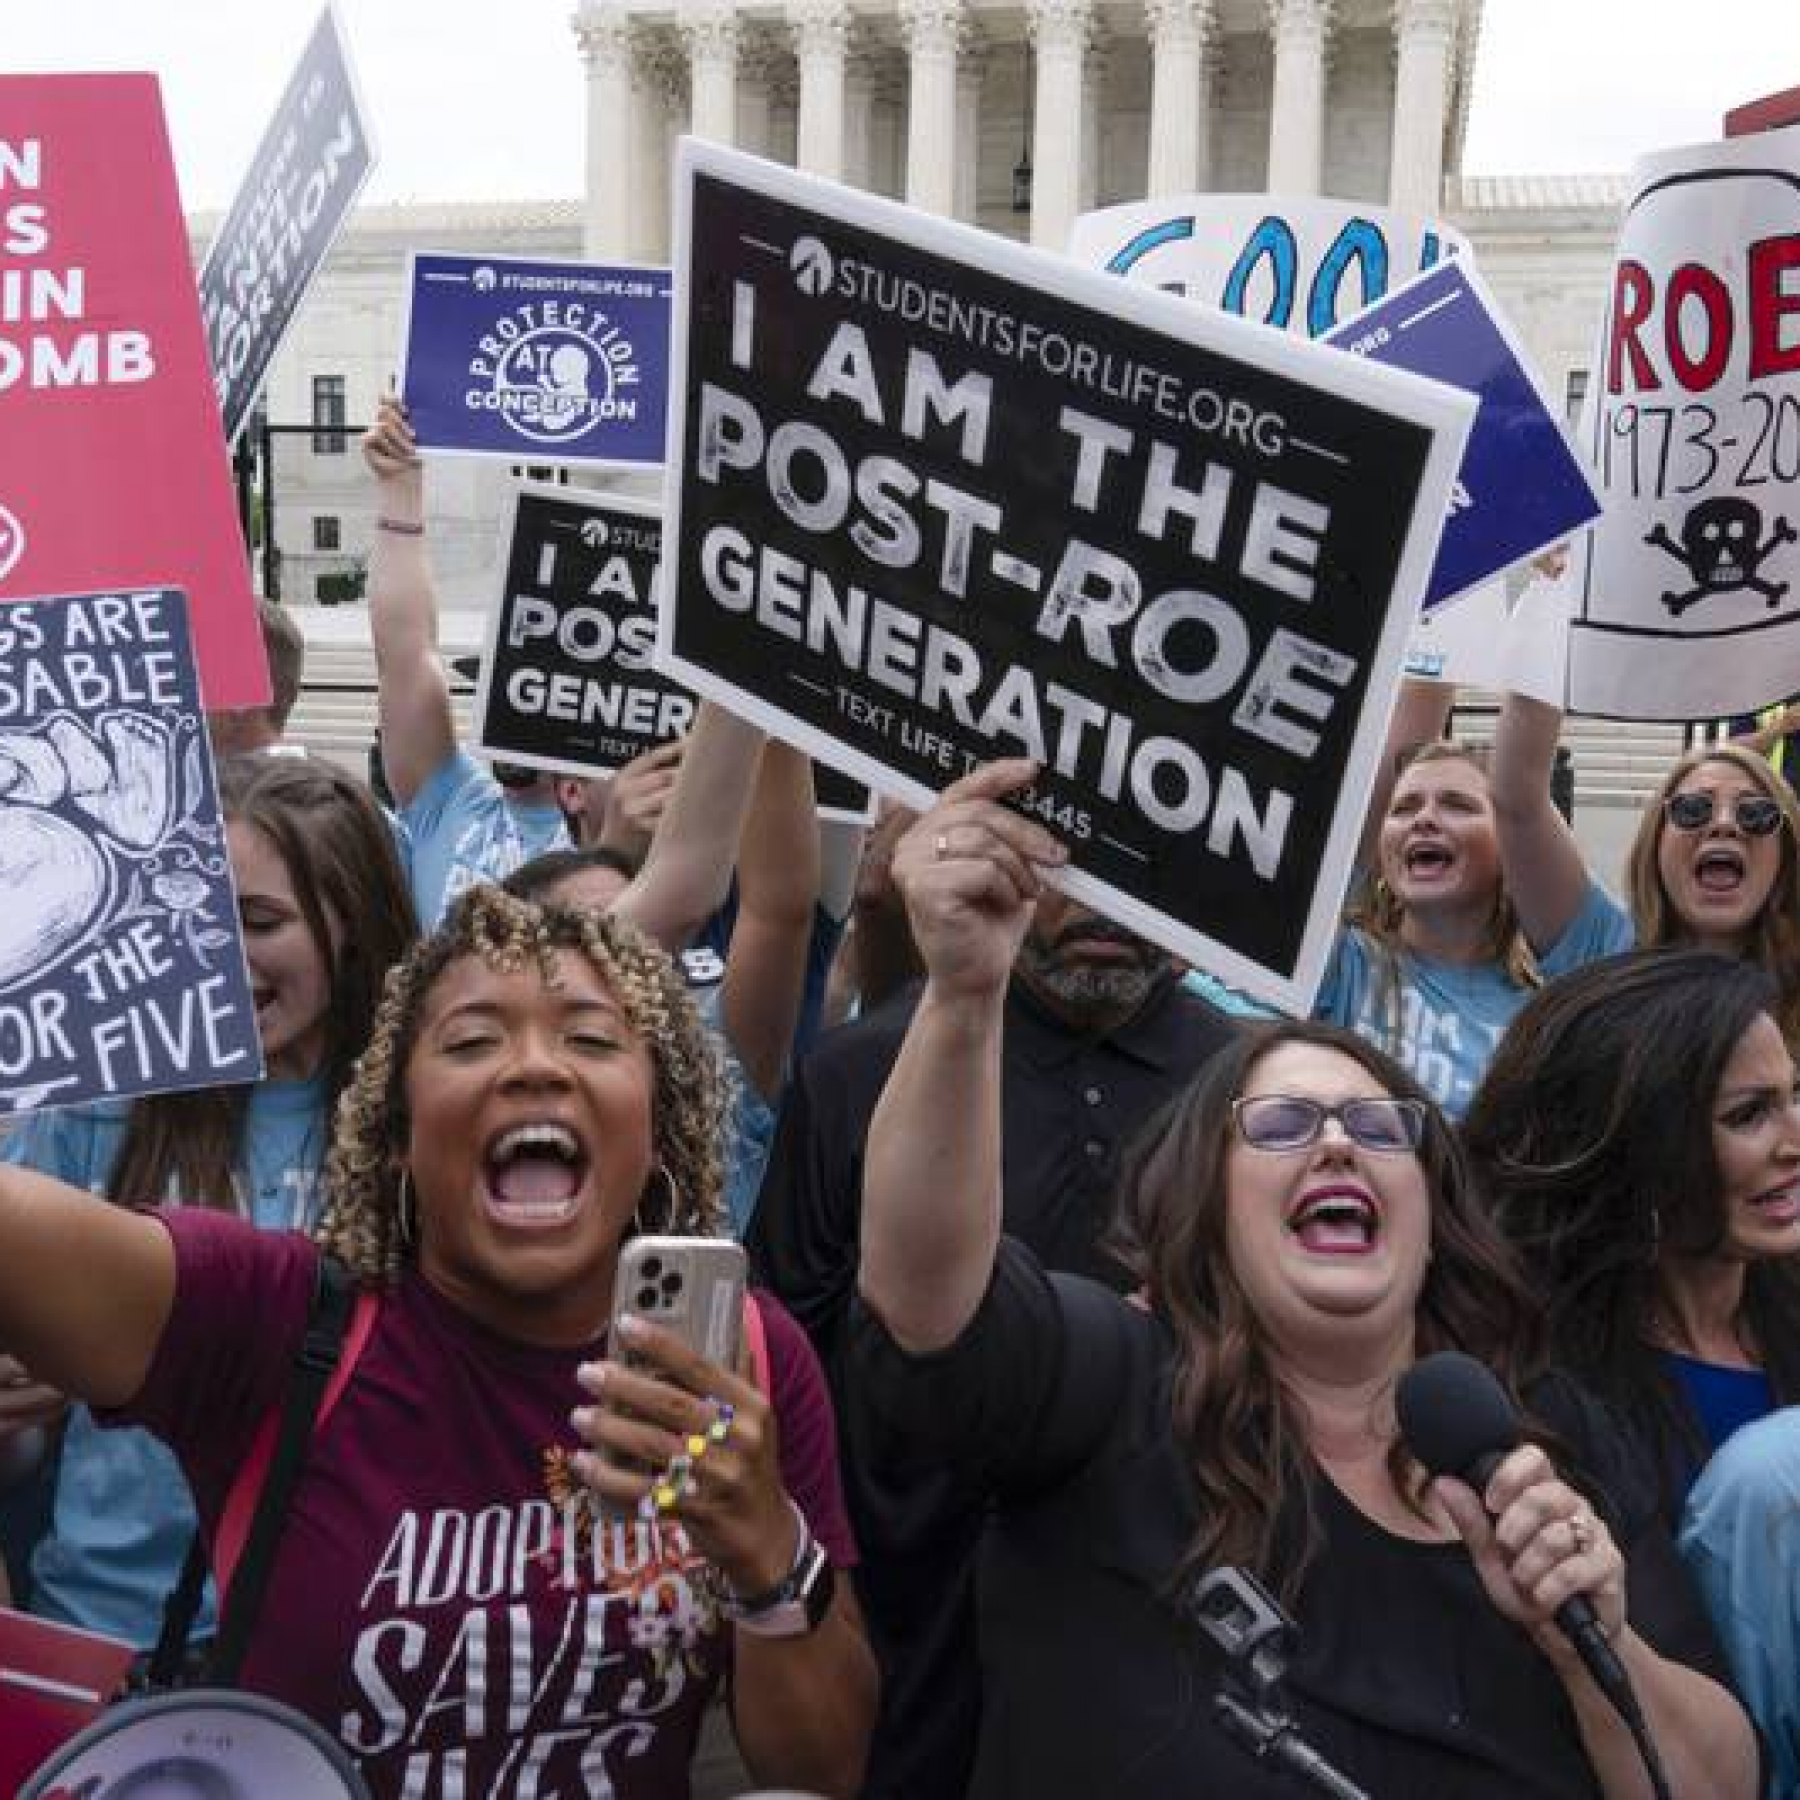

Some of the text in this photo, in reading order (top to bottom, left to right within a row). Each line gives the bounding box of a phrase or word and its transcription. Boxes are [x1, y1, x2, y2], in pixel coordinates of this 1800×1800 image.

[3, 268, 85, 322] IN
[468, 300, 641, 383] PROTECTION
[515, 344, 551, 372] AT
[841, 258, 1285, 456] STUDENTSFORLIFE.ORG
[465, 387, 637, 422] CONCEPTION
[732, 279, 1331, 600] I AM THE
[536, 543, 557, 586] I
[698, 382, 1359, 759] POST-ROE
[66, 593, 170, 647] ARE
[700, 524, 1298, 882] GENERATION
[836, 686, 895, 737] TEXT
[901, 718, 955, 771] LIFE
[72, 919, 173, 1003] THE
[91, 974, 248, 1092] FIVE
